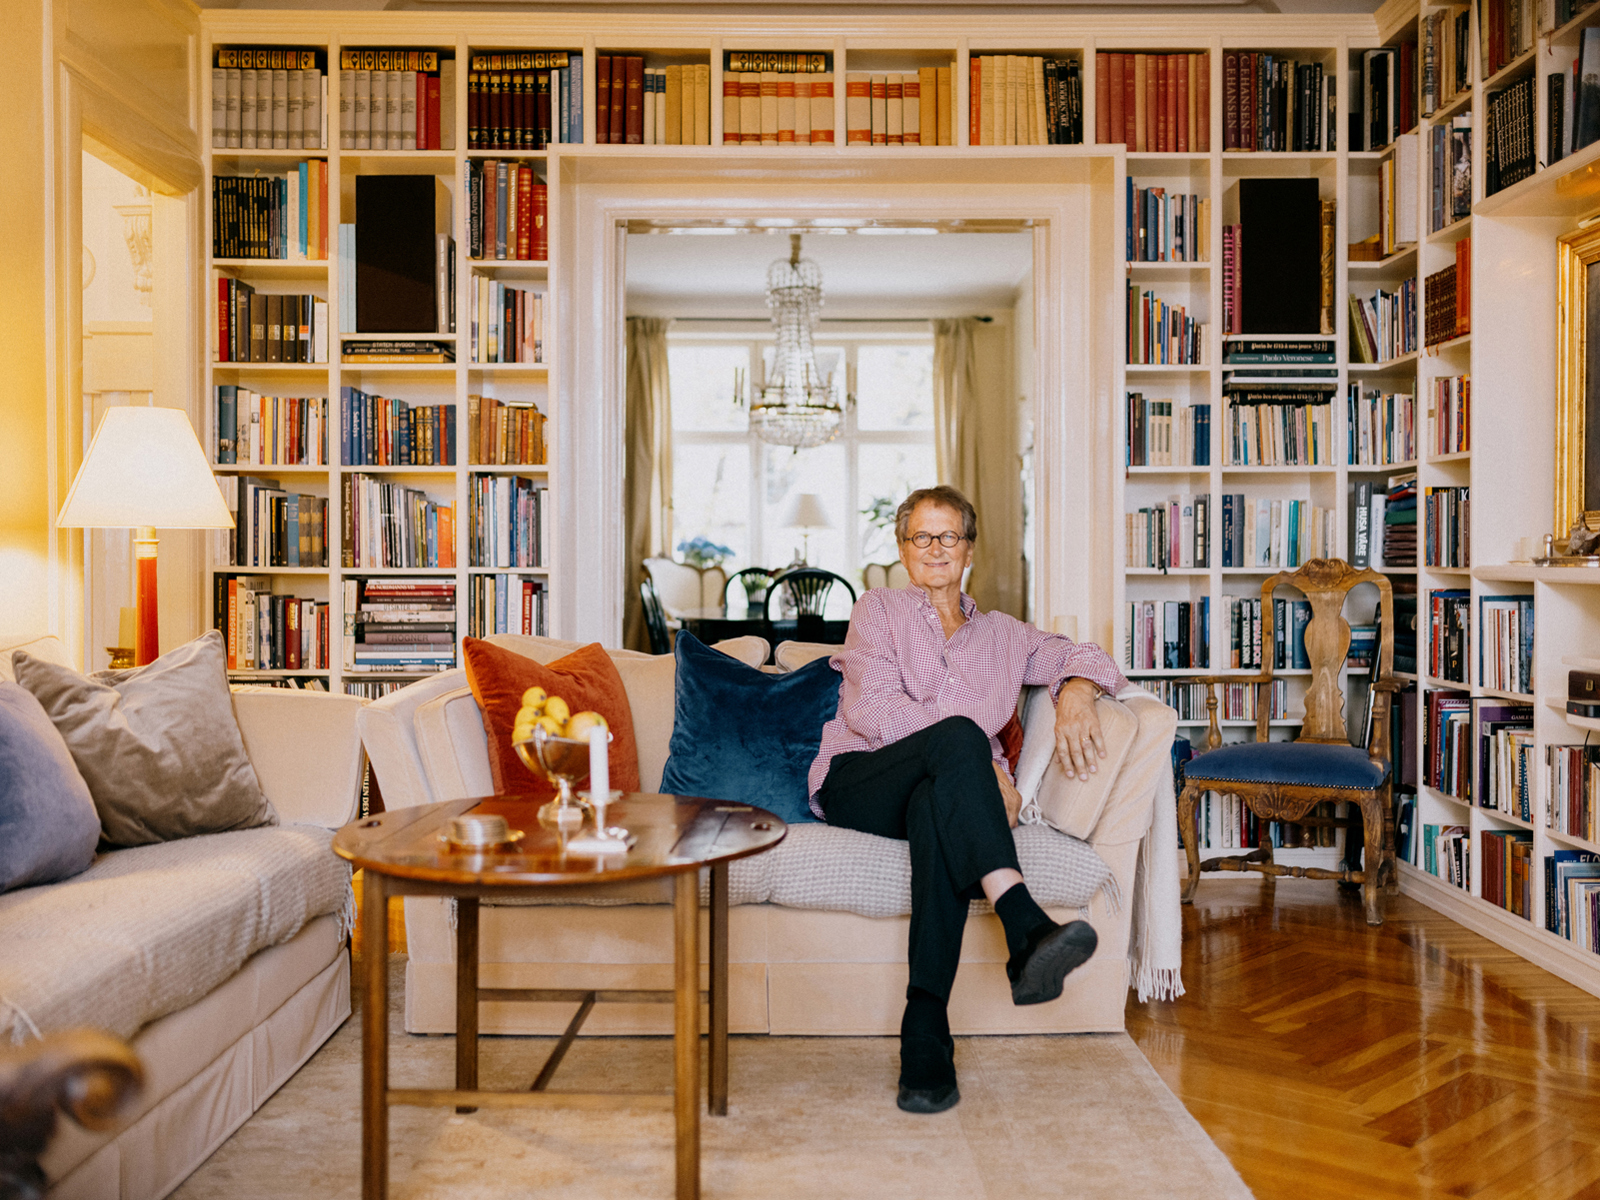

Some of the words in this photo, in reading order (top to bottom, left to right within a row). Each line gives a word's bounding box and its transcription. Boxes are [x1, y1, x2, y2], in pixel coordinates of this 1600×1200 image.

[471, 177, 479, 215] Arneberg
[1223, 233, 1233, 315] anemone
[1359, 507, 1367, 531] HUSA
[1358, 532, 1368, 556] VÅRE
[387, 634, 429, 642] FROGNER
